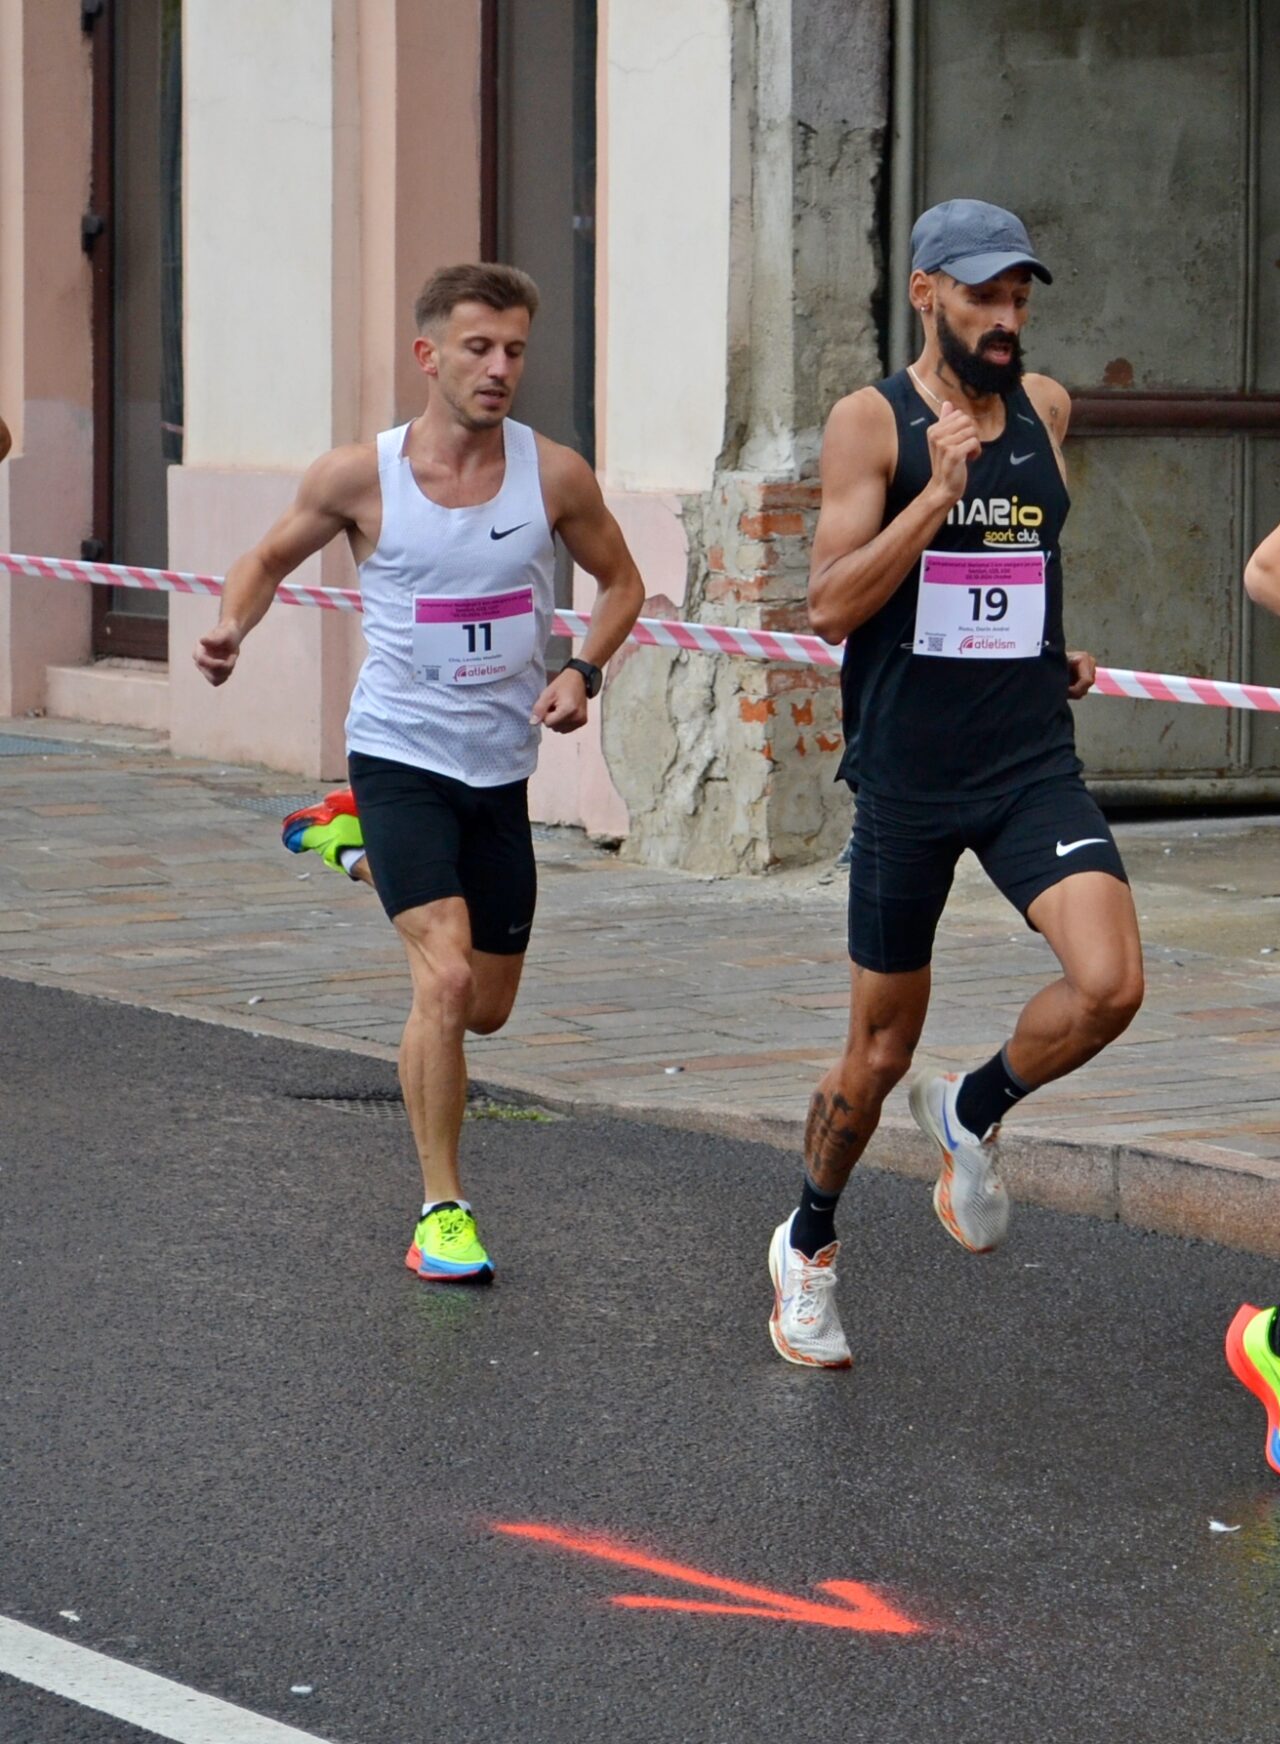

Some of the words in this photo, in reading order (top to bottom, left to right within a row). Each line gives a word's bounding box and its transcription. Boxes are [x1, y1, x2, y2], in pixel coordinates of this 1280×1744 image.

[985, 528, 1014, 542] sport
[1017, 528, 1039, 542] club
[968, 587, 1008, 621] 19
[462, 623, 492, 652] 11
[974, 637, 1016, 649] atletism
[468, 665, 506, 677] atletism
